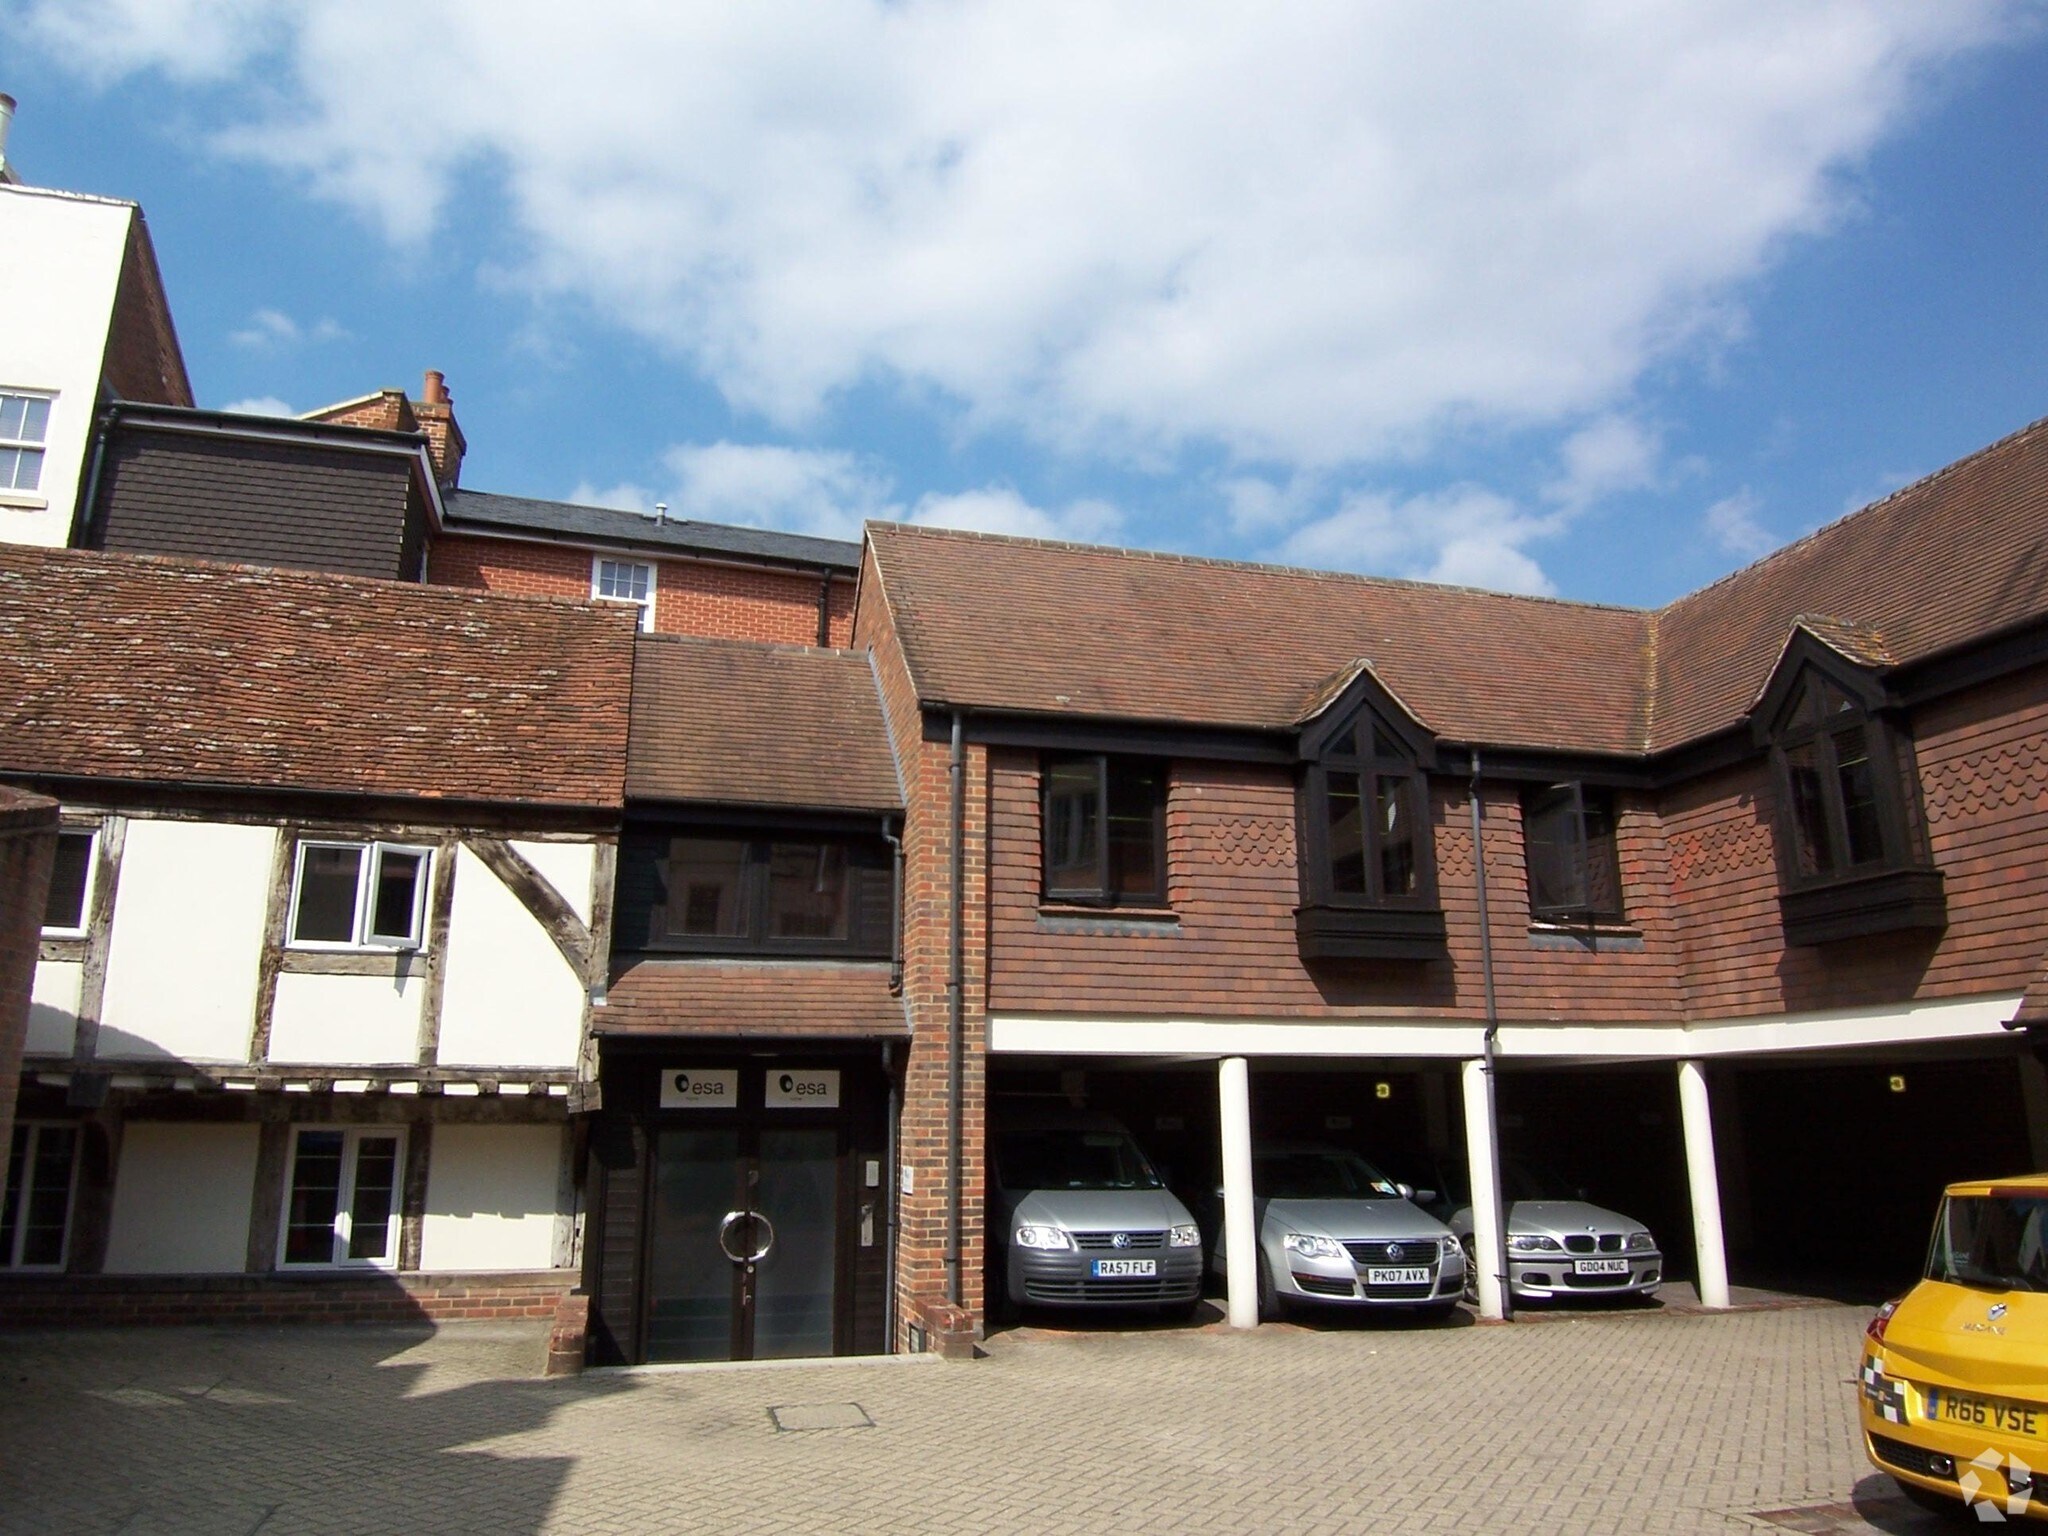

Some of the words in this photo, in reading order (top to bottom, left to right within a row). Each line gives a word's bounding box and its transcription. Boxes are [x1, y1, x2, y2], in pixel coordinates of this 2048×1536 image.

[692, 1082, 724, 1095] esa
[796, 1082, 827, 1095] esa
[1101, 1262, 1131, 1274] RA57
[1133, 1261, 1153, 1273] FLF
[1579, 1262, 1605, 1272] GD04
[1607, 1261, 1625, 1271] NUC
[1373, 1270, 1402, 1282] PK07
[1405, 1270, 1426, 1282] AVX
[1945, 1396, 1985, 1424] R66
[1993, 1404, 2037, 1434] VSE
